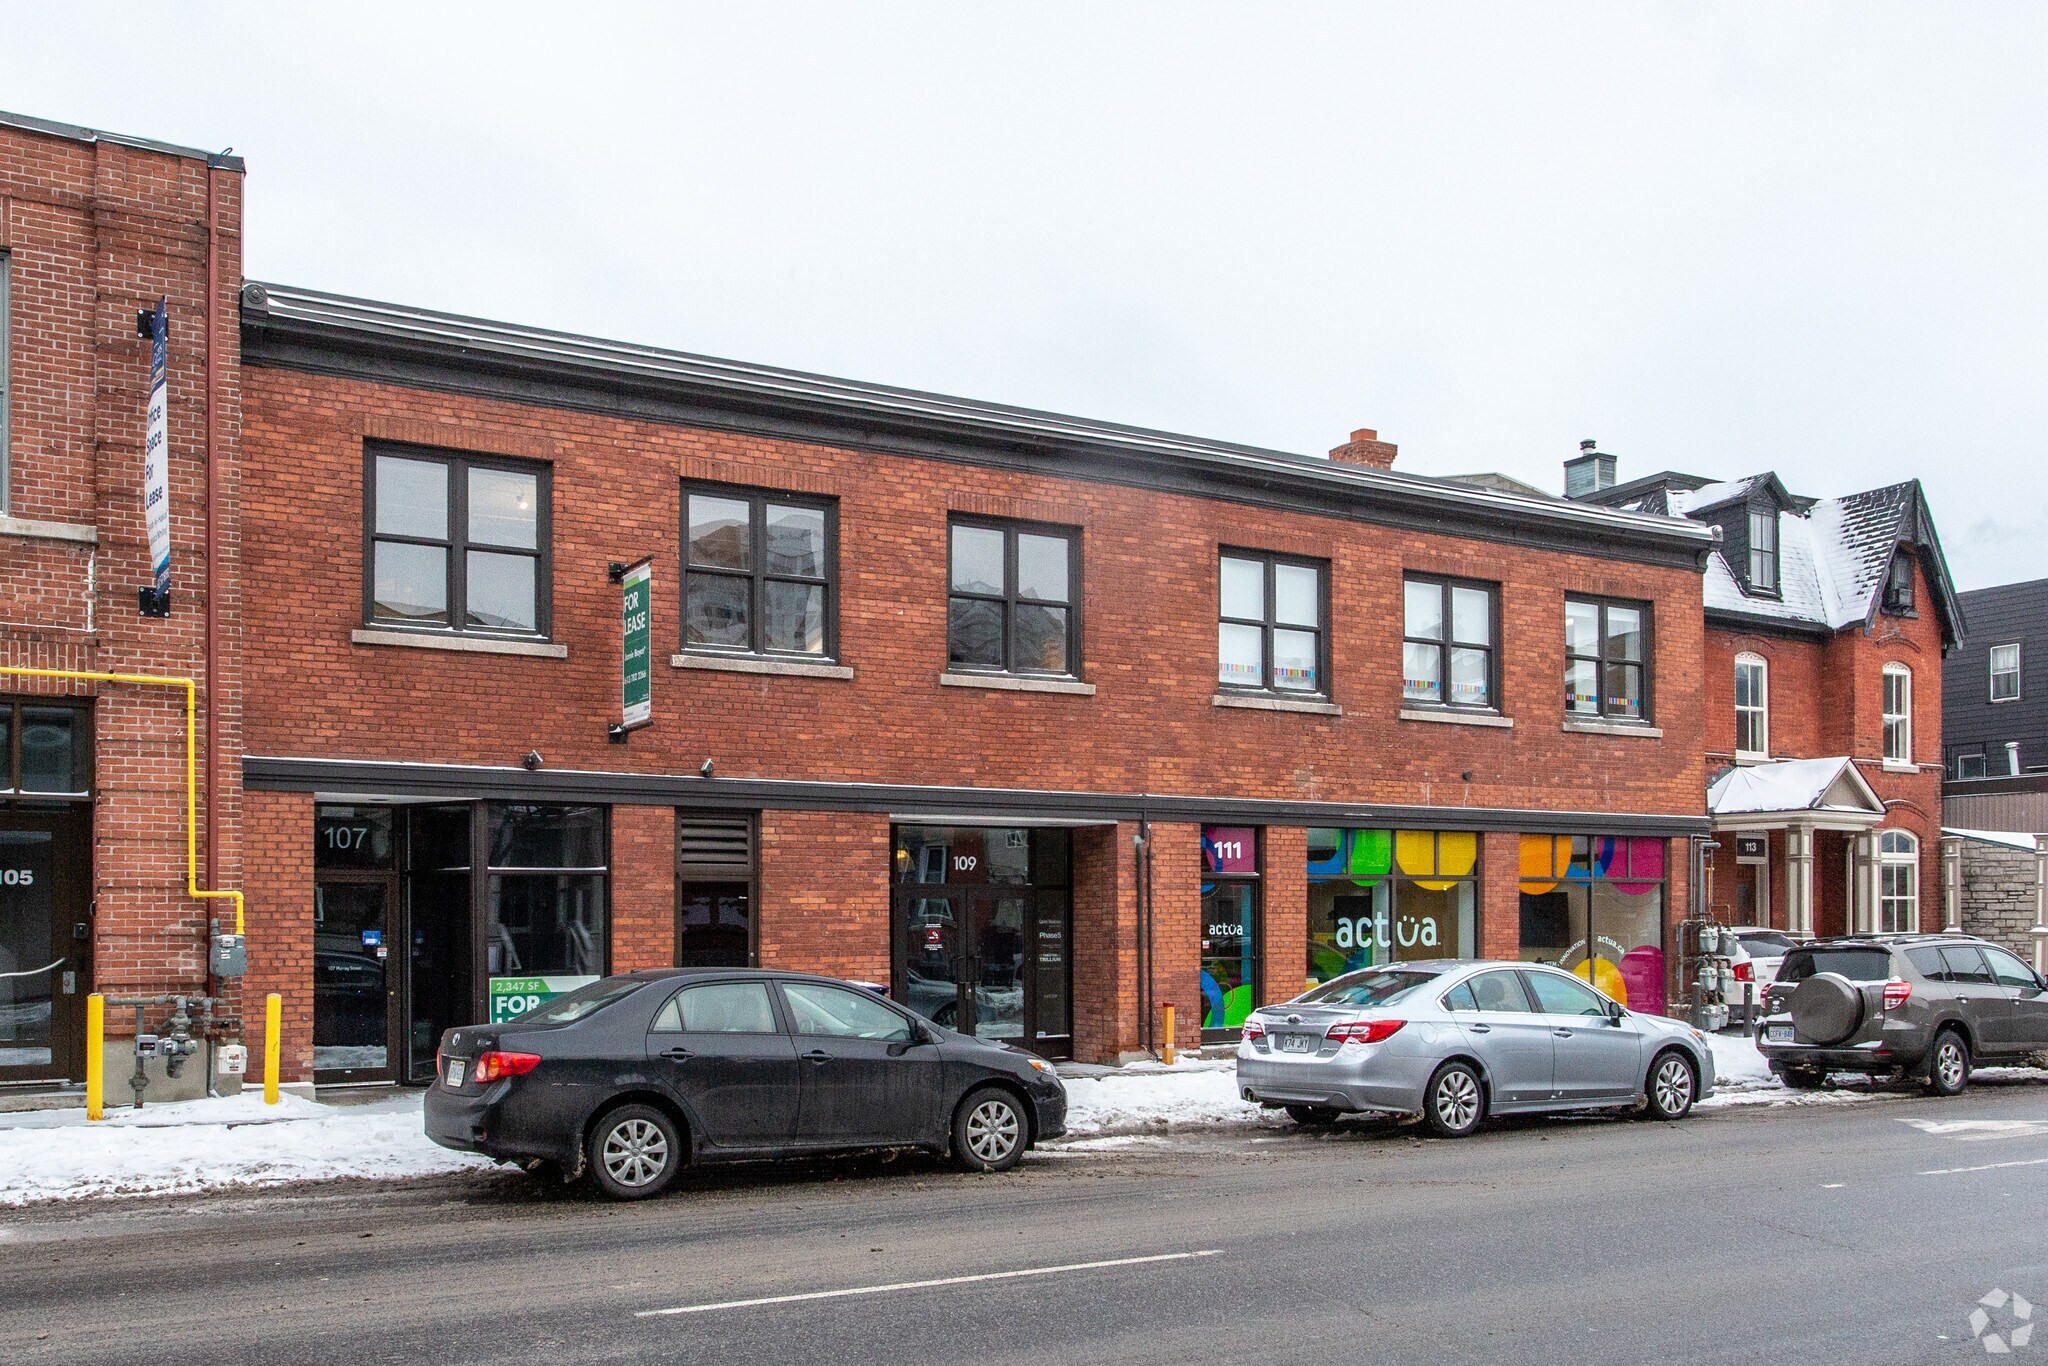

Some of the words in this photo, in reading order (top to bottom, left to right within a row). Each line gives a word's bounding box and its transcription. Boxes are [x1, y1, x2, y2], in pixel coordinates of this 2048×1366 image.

[145, 485, 163, 510] Lease
[624, 591, 639, 613] FOR
[624, 611, 646, 636] LEASE
[324, 826, 368, 849] 107
[1745, 842, 1757, 852] 113
[1213, 841, 1242, 859] 111
[953, 855, 977, 871] 109
[1559, 938, 1586, 965] INNOVATION
[1597, 935, 1625, 955] actua.ca
[496, 981, 525, 993] 2,347
[528, 981, 540, 991] SF
[496, 995, 540, 1014] FOR
